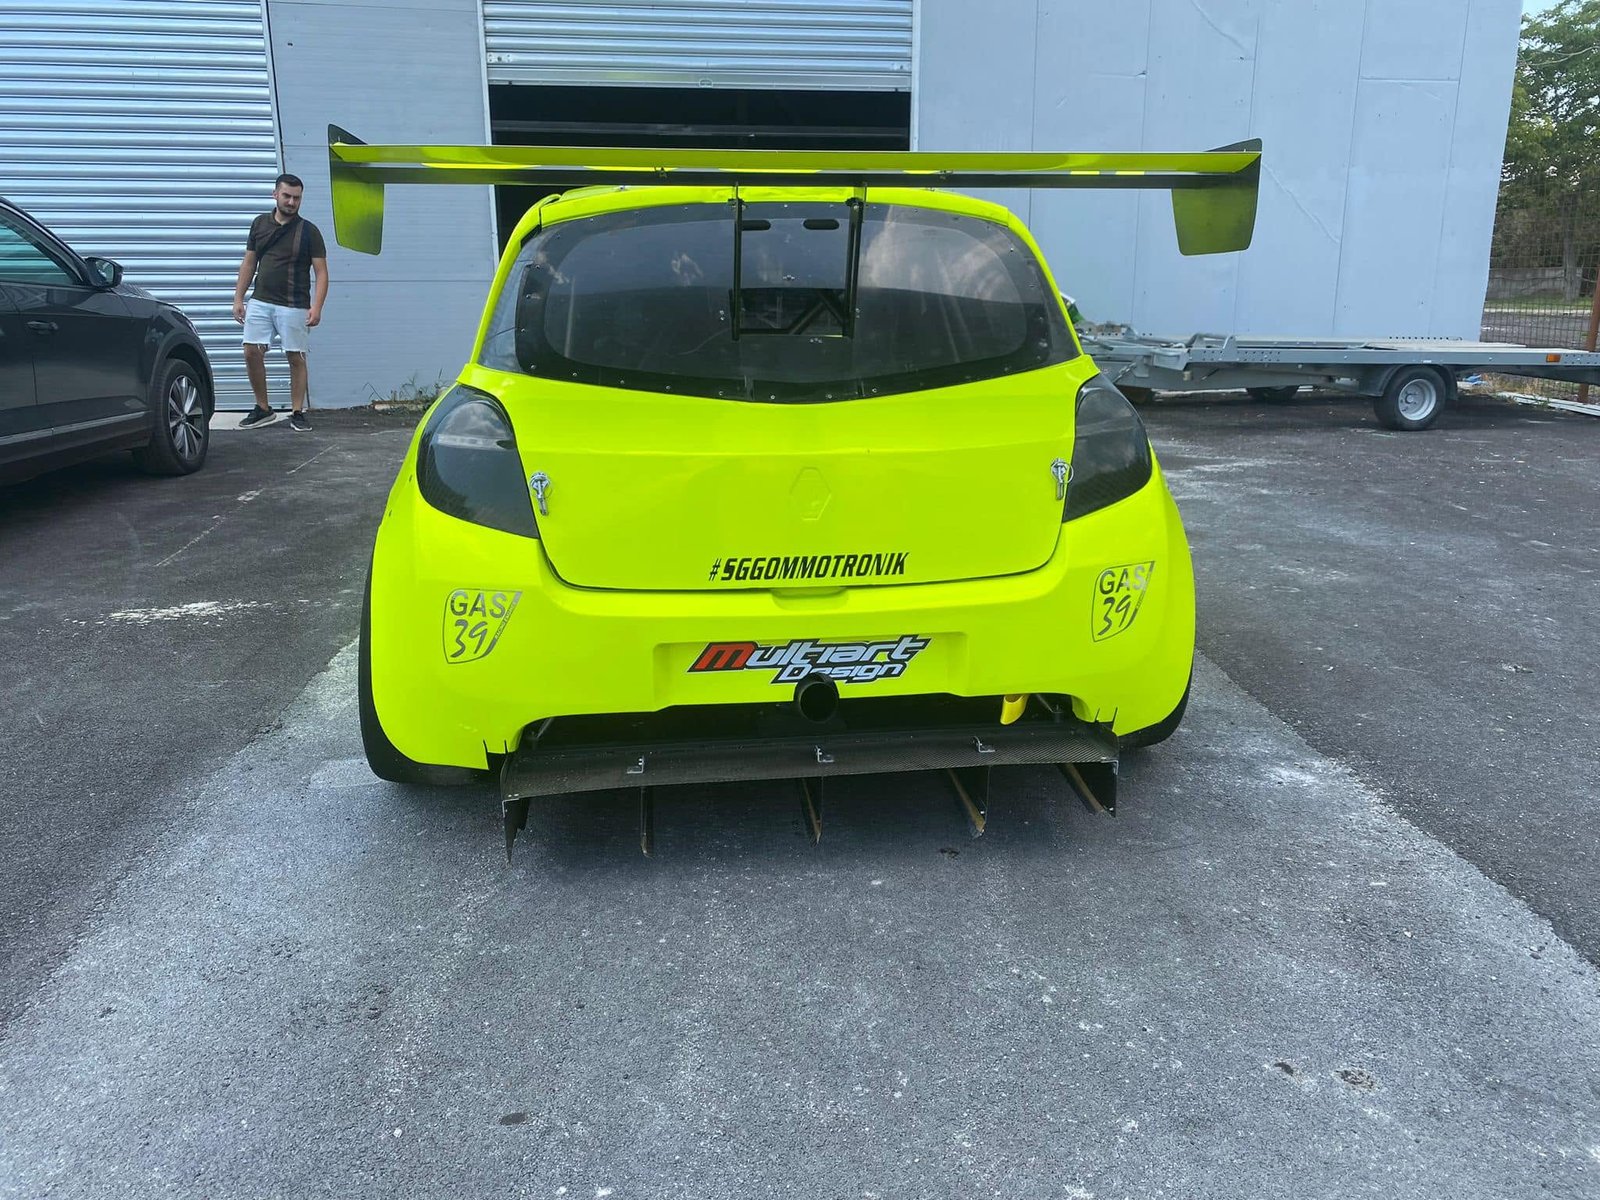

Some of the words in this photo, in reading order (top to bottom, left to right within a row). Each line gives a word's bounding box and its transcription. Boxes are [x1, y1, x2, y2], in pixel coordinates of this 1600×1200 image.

[709, 552, 909, 581] #SGGOMMOTRONIK
[1100, 565, 1145, 594] GAS
[450, 591, 506, 618] GAS
[1098, 594, 1131, 636] 39
[450, 619, 488, 658] 39
